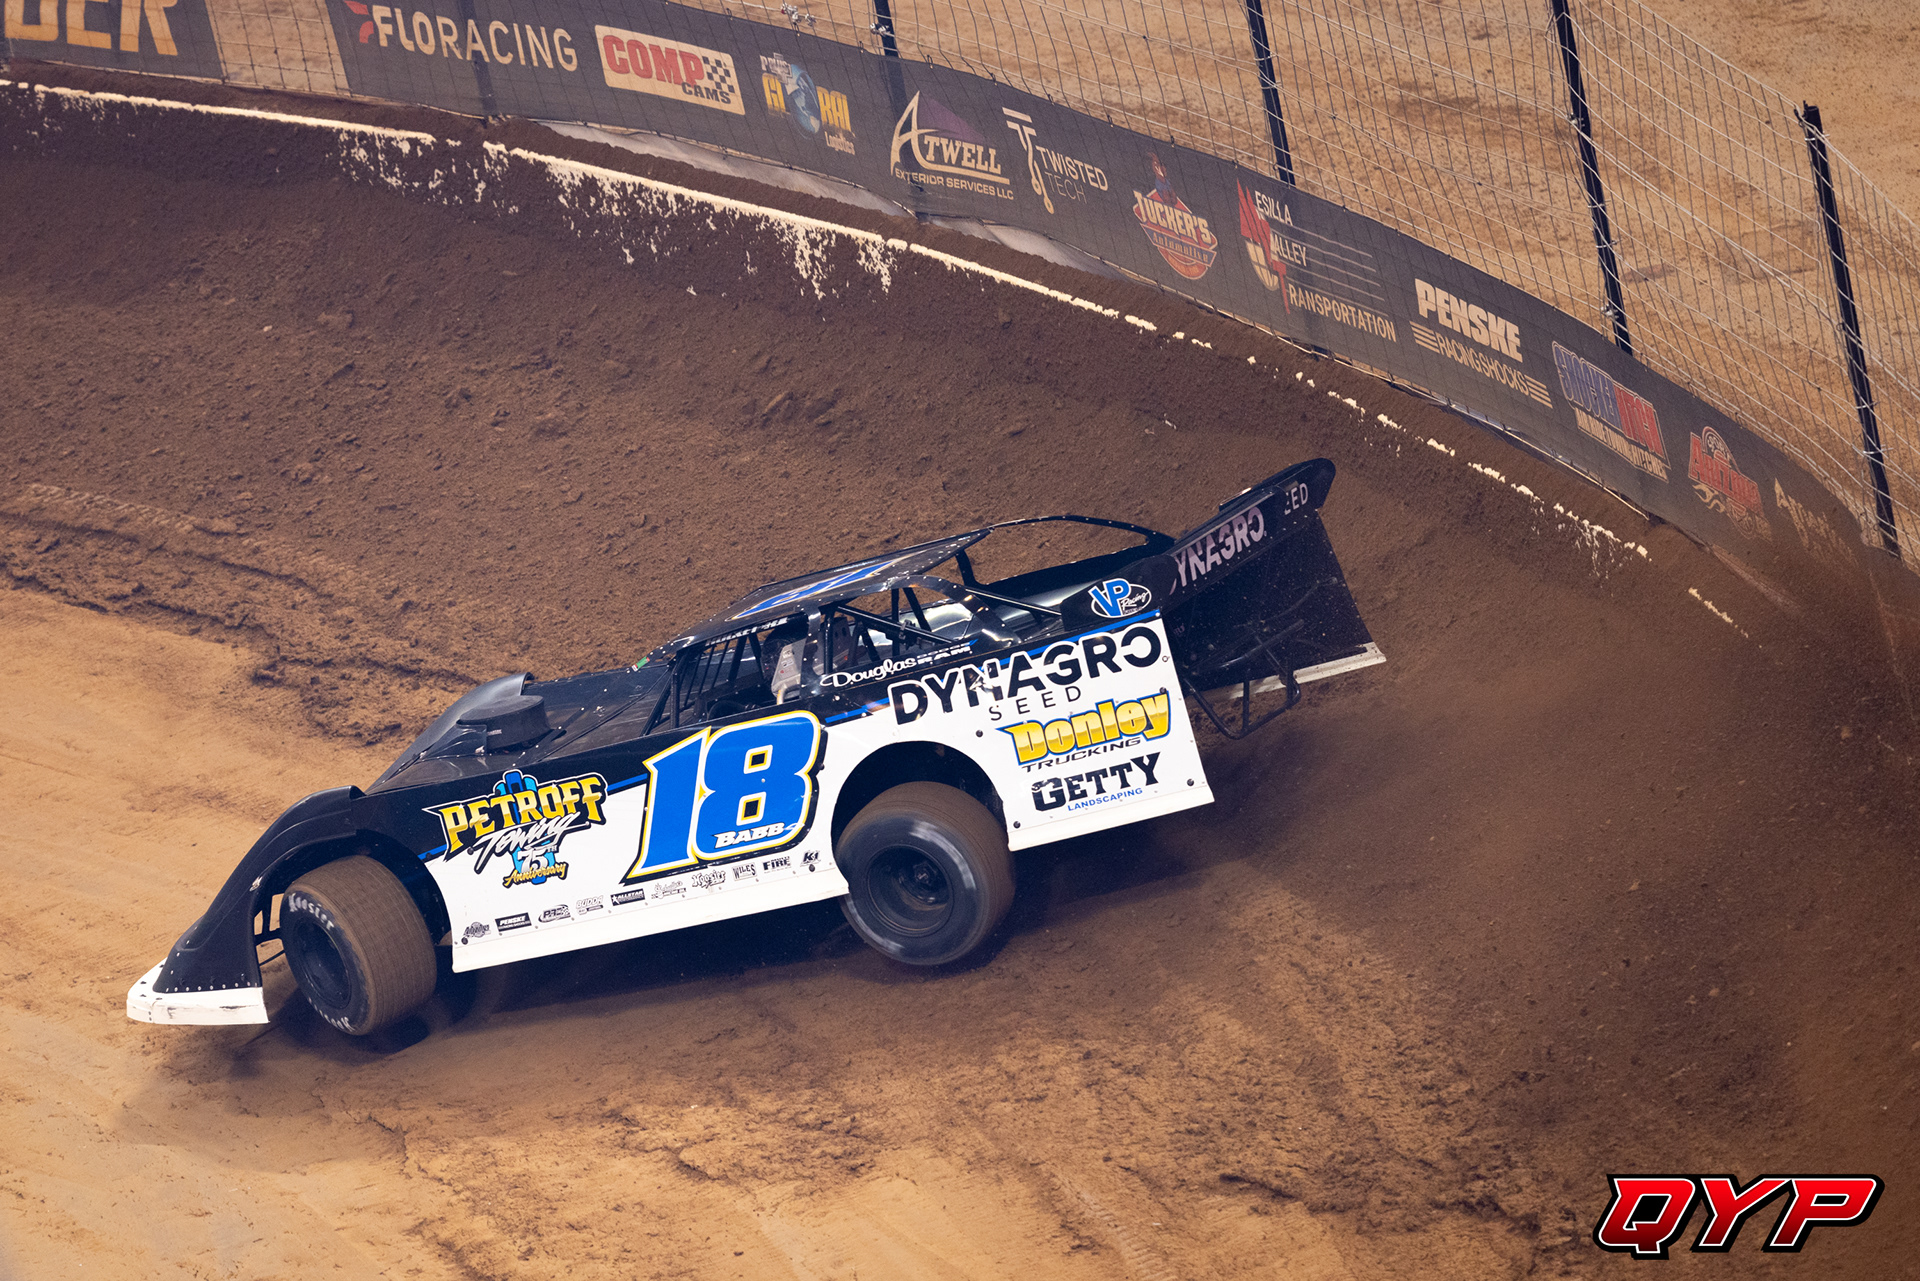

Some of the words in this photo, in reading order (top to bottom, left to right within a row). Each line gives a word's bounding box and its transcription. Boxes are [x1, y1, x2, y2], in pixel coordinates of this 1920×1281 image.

[371, 5, 579, 72] FLORACING
[602, 34, 706, 87] COMP
[681, 81, 732, 105] CAMS
[890, 91, 1002, 176] ATWELL
[895, 168, 945, 187] EXTERIOR
[946, 177, 996, 196] SERVICES
[996, 186, 1014, 200] LLC
[1035, 145, 1109, 192] TWISTED
[1044, 170, 1088, 204] TECH
[1132, 190, 1212, 246] TUCKER'S
[1414, 278, 1523, 363] PENSKE
[1088, 577, 1132, 617] VP
[819, 658, 918, 688] Douglas
[890, 626, 1162, 725] DYNAGRO
[988, 685, 1082, 721] SEED
[1000, 691, 1172, 765] Donley
[1021, 736, 1141, 774] TRUCKING
[625, 709, 822, 880] 18
[1031, 751, 1162, 812] GETTY
[1067, 787, 1143, 812] LANDSCAPING
[438, 776, 603, 854] PETROFF
[713, 822, 786, 849] BABB
[472, 812, 582, 872] Towing
[503, 863, 568, 888] Anniversary
[733, 863, 757, 880] WILES
